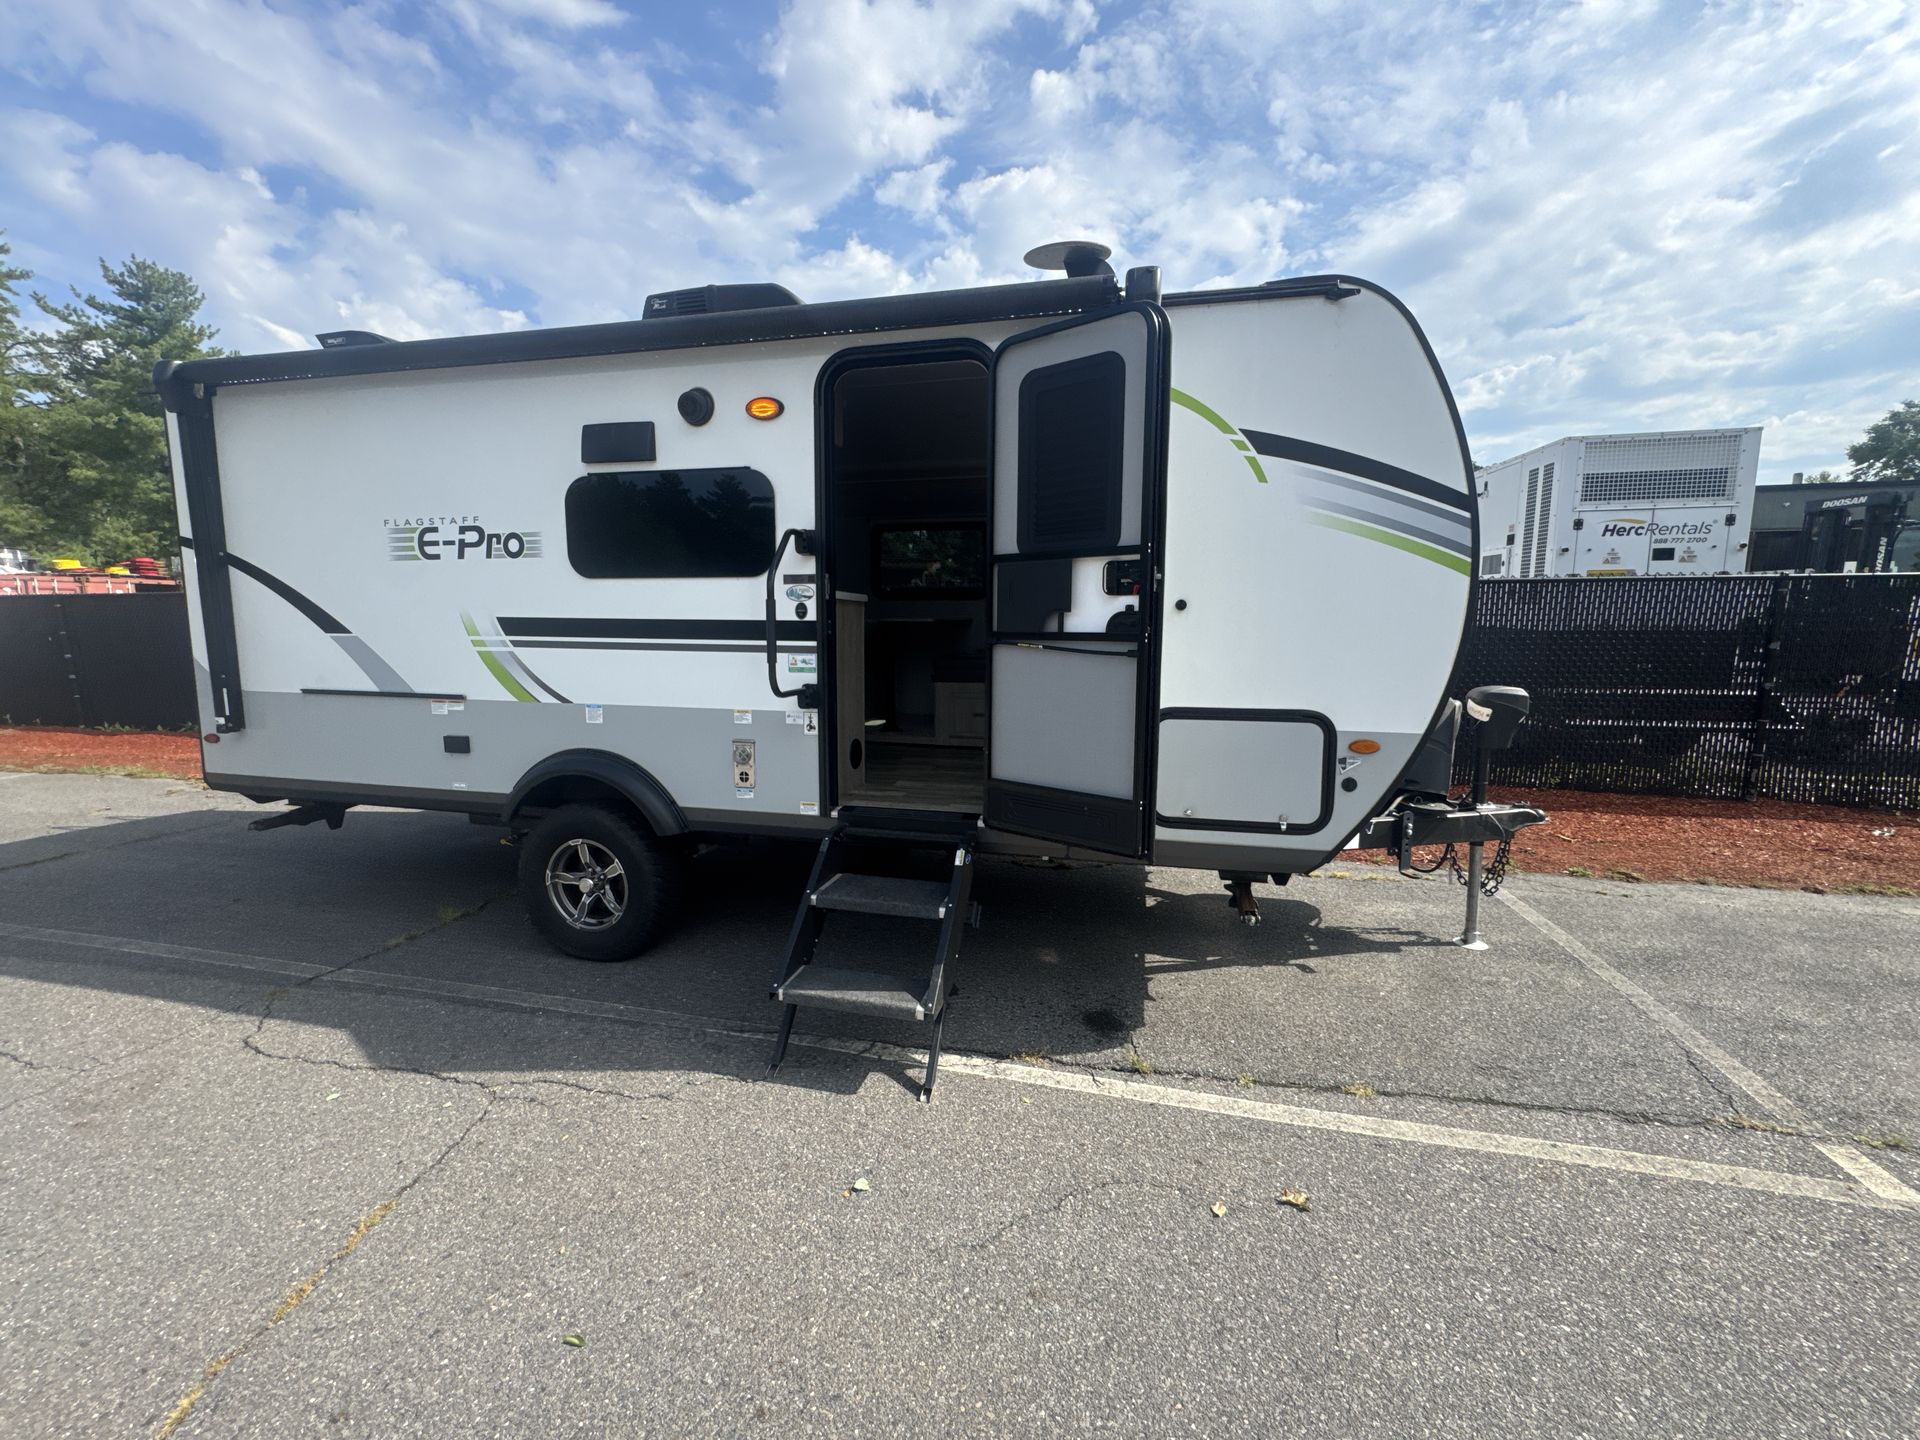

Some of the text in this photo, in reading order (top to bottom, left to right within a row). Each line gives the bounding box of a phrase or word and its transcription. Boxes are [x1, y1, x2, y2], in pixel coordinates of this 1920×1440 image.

[1822, 496, 1868, 508] DOOSAN
[383, 516, 480, 527] FLAGSTAFF
[417, 525, 525, 560] E-Pro
[1875, 536, 1888, 574] OOSAN
